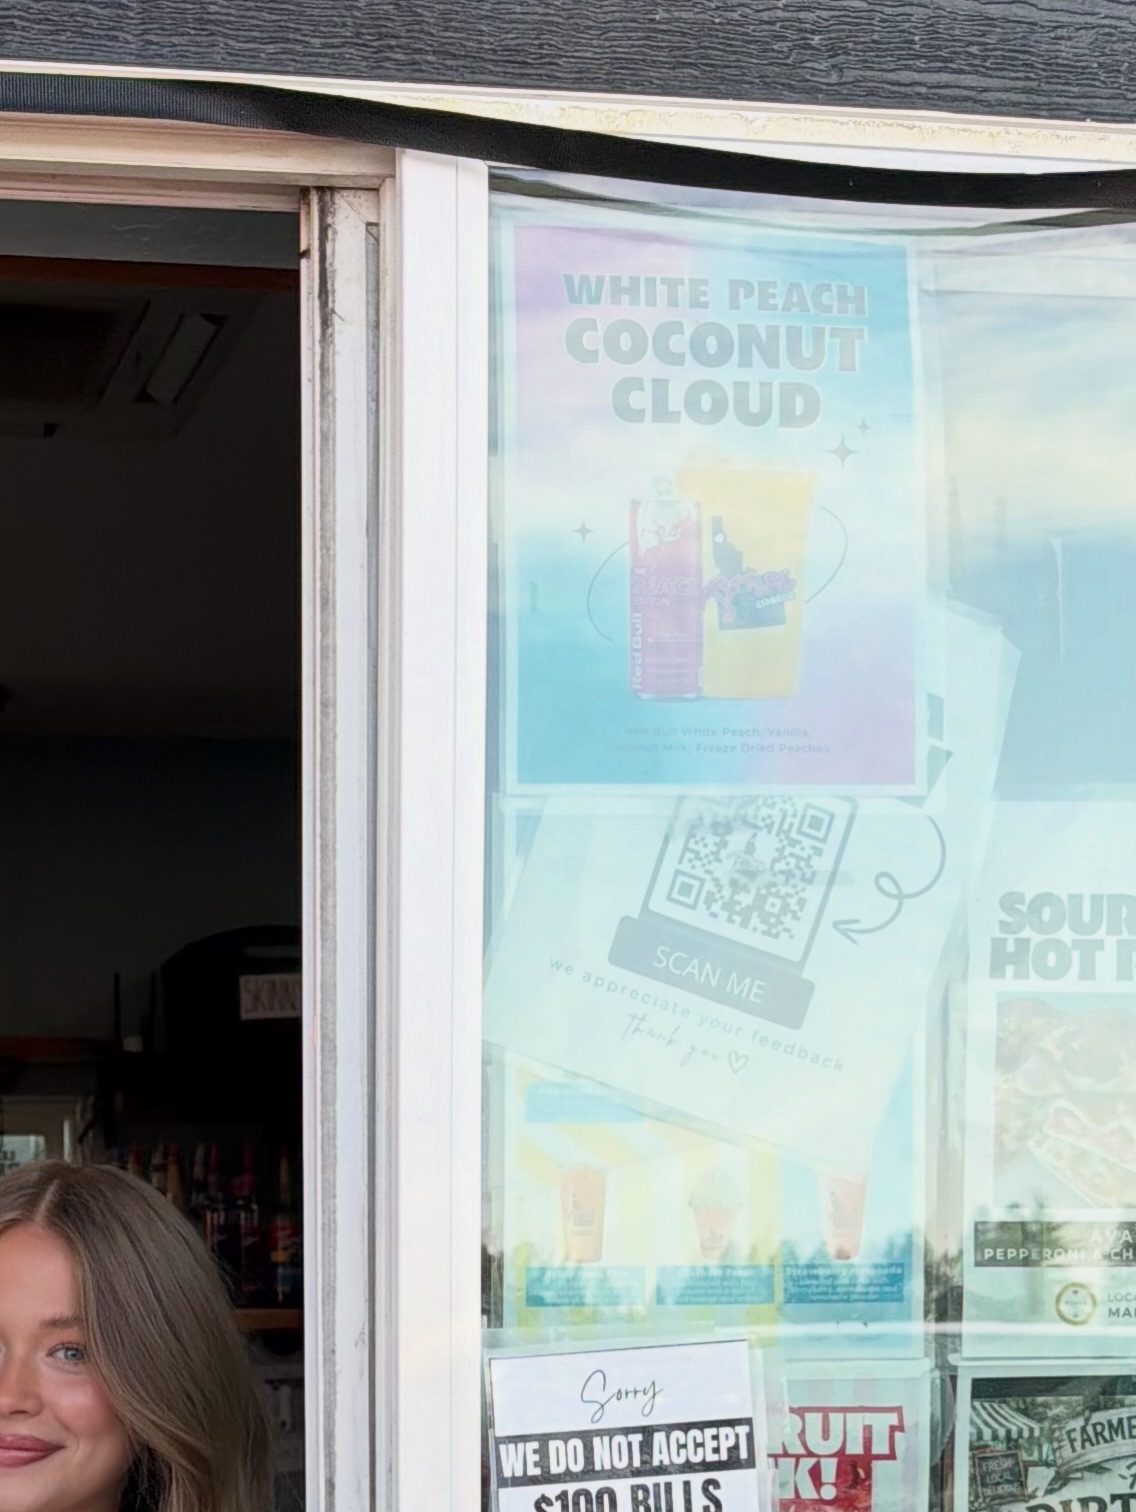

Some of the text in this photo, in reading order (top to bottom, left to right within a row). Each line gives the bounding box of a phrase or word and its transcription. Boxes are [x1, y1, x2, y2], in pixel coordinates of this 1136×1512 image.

[563, 273, 866, 316] WHITE PEACH
[564, 317, 866, 373] COCONUT
[611, 376, 821, 428] CLOUD
[651, 945, 768, 1005] SCAN ME
[989, 936, 1104, 981] HOT
[548, 956, 845, 1073] we appreciate your feedback
[984, 1248, 1084, 1260] PEPPERONI
[580, 1369, 664, 1423] Sorry
[499, 1425, 750, 1478] WE DO NOT ACCEPT
[982, 1460, 1013, 1470] FRESH
[986, 1472, 1013, 1483] LOCAL
